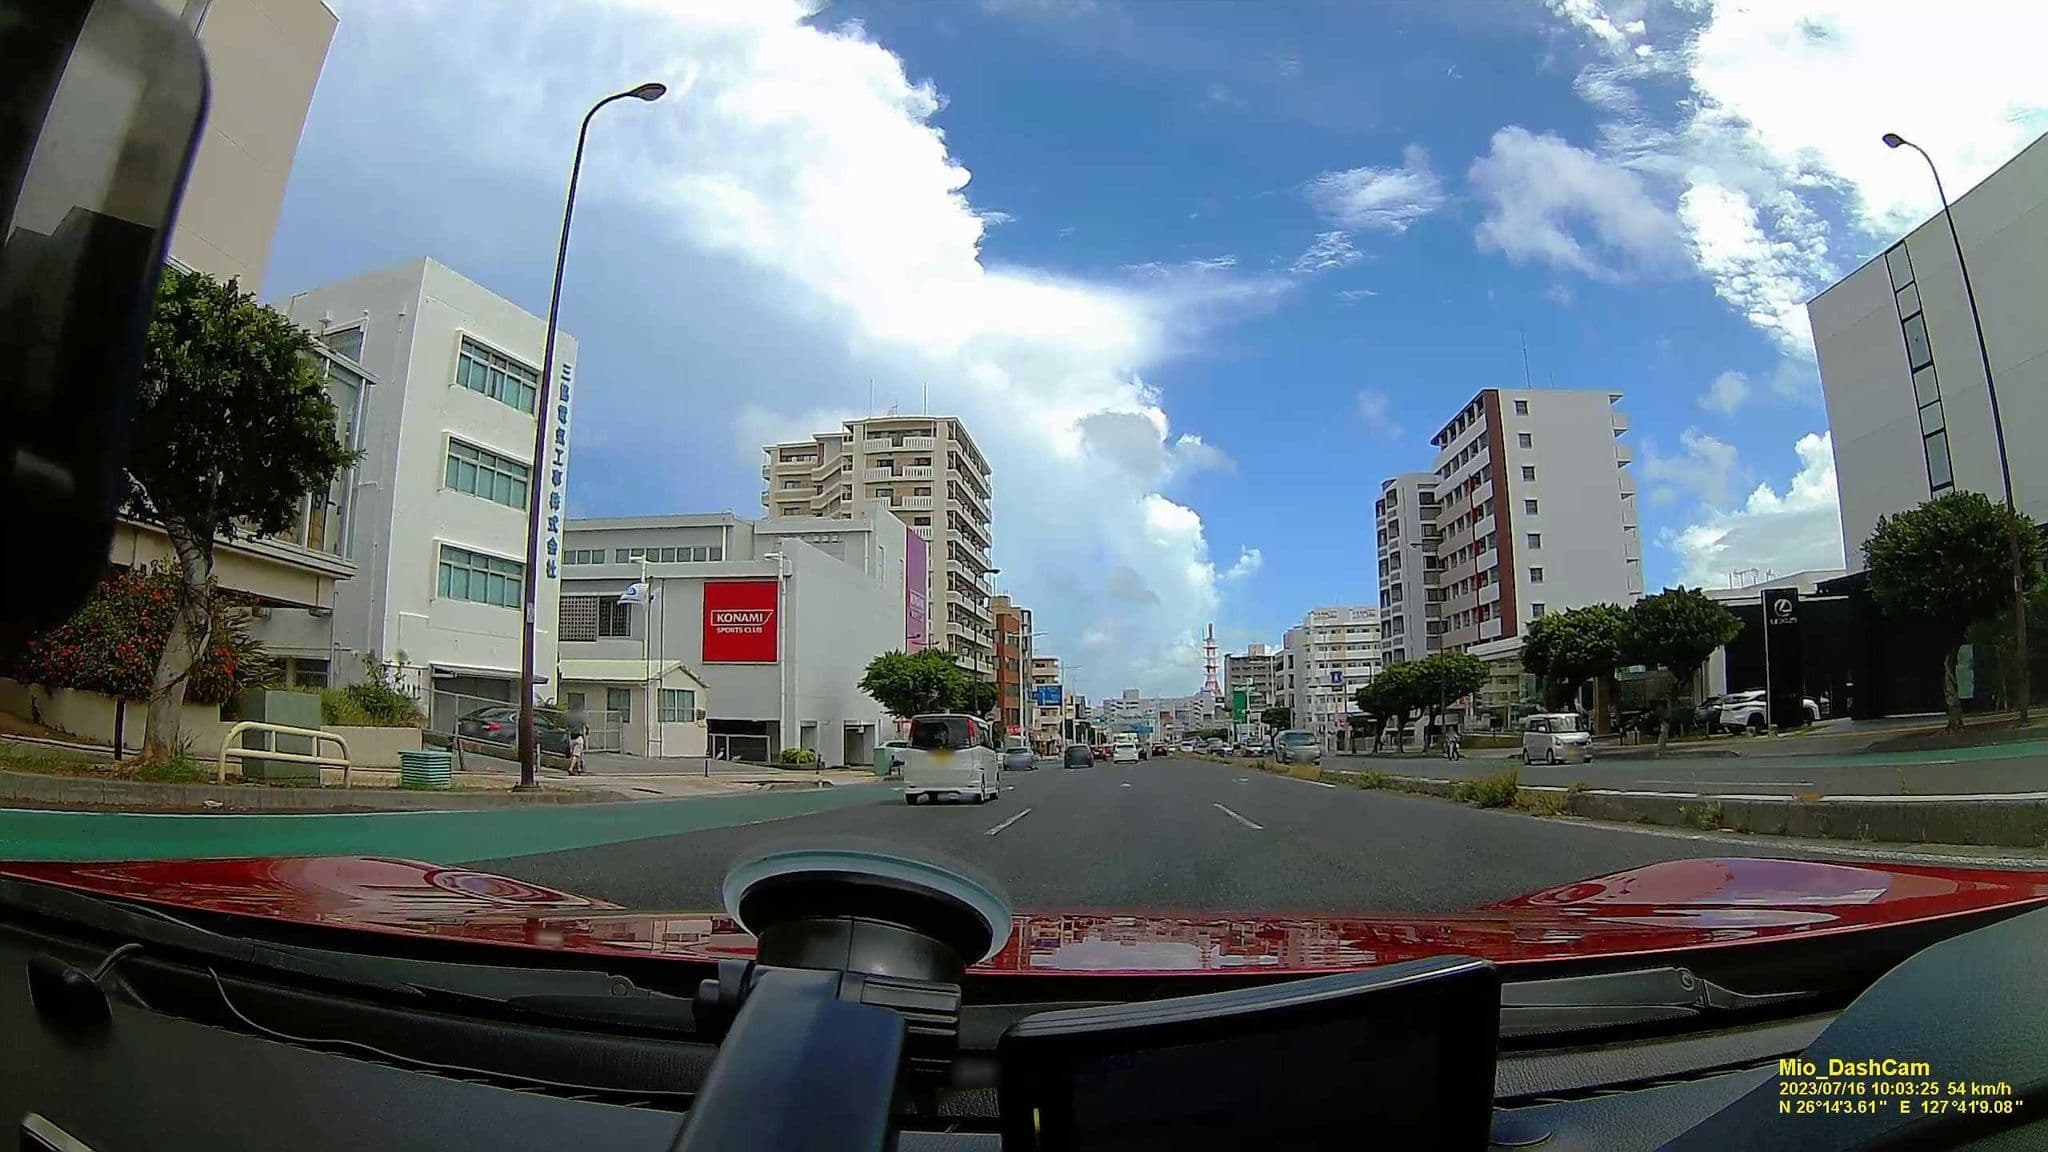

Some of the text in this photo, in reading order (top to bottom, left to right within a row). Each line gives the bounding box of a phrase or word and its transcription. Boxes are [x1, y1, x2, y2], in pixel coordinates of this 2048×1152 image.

[717, 613, 763, 623] KONAMI
[717, 626, 763, 634] SPORTS CLUB
